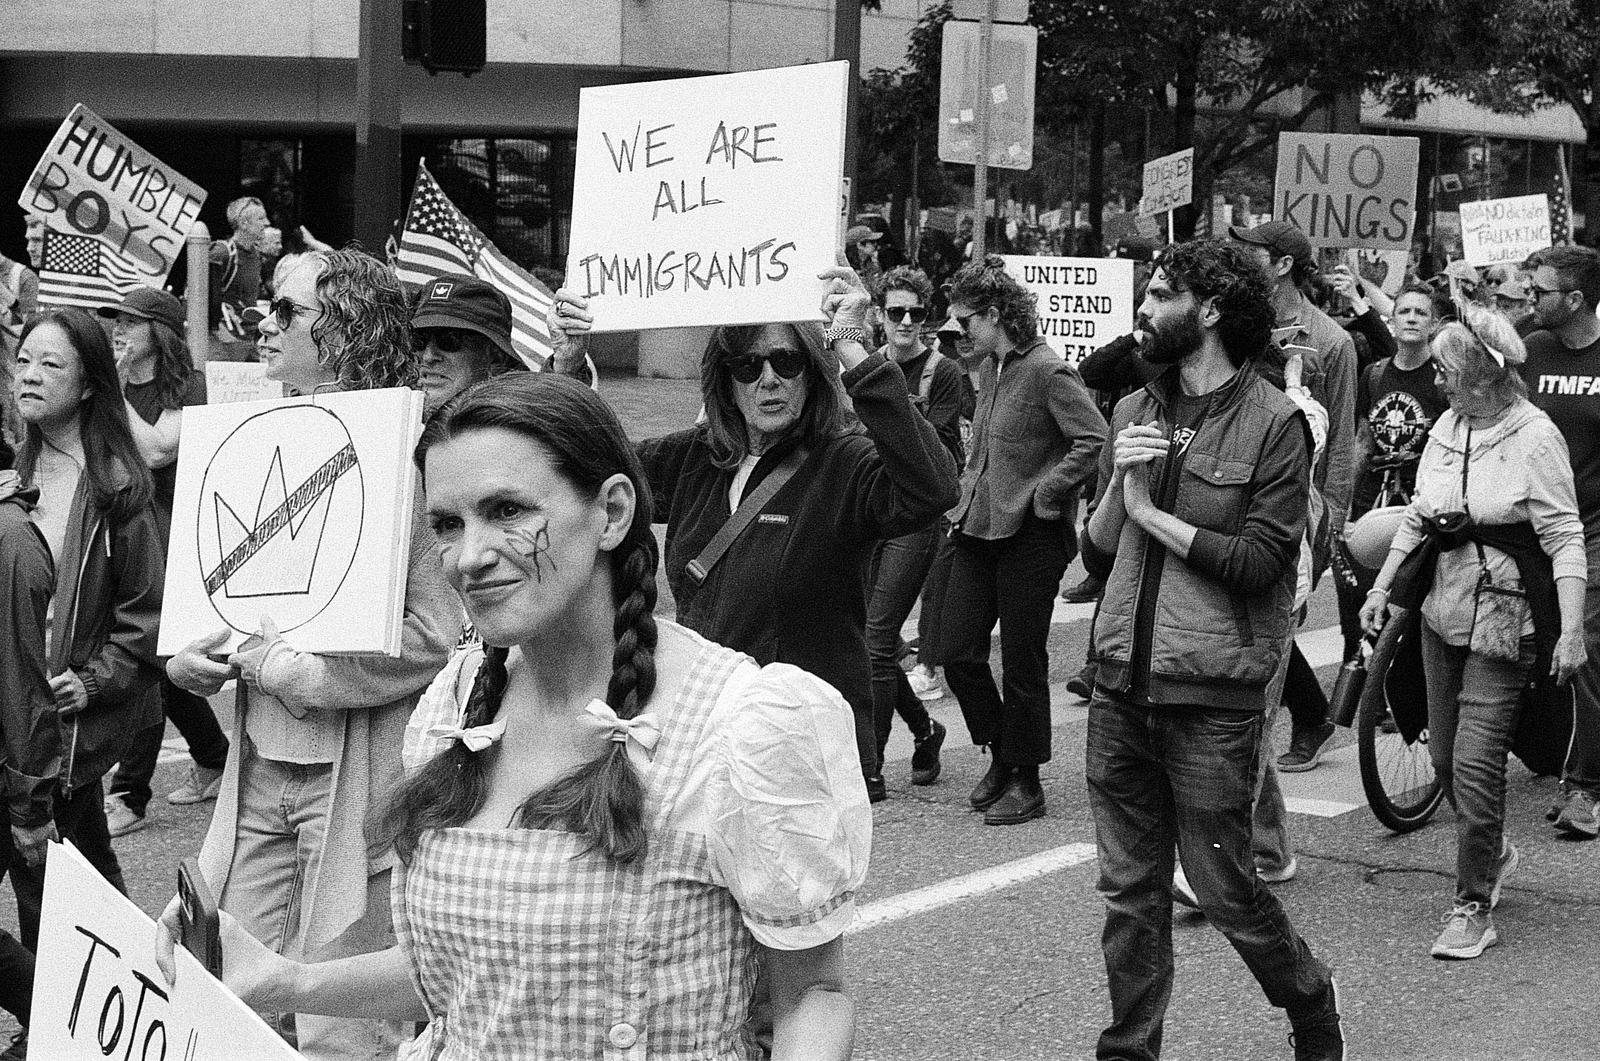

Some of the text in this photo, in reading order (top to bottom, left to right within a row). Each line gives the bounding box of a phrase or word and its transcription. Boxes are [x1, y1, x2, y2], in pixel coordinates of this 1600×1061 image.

[602, 119, 784, 173] WE ARE
[1296, 143, 1384, 189] NO
[57, 115, 200, 235] HUMBLE
[652, 176, 725, 221] ALL
[31, 162, 174, 277] BOYS
[1283, 190, 1409, 242] KINGS
[579, 238, 796, 299] IMMIGRANTS
[1024, 266, 1097, 285] UNITED
[1049, 295, 1112, 314] STAND
[1538, 375, 1600, 395] ITMFA
